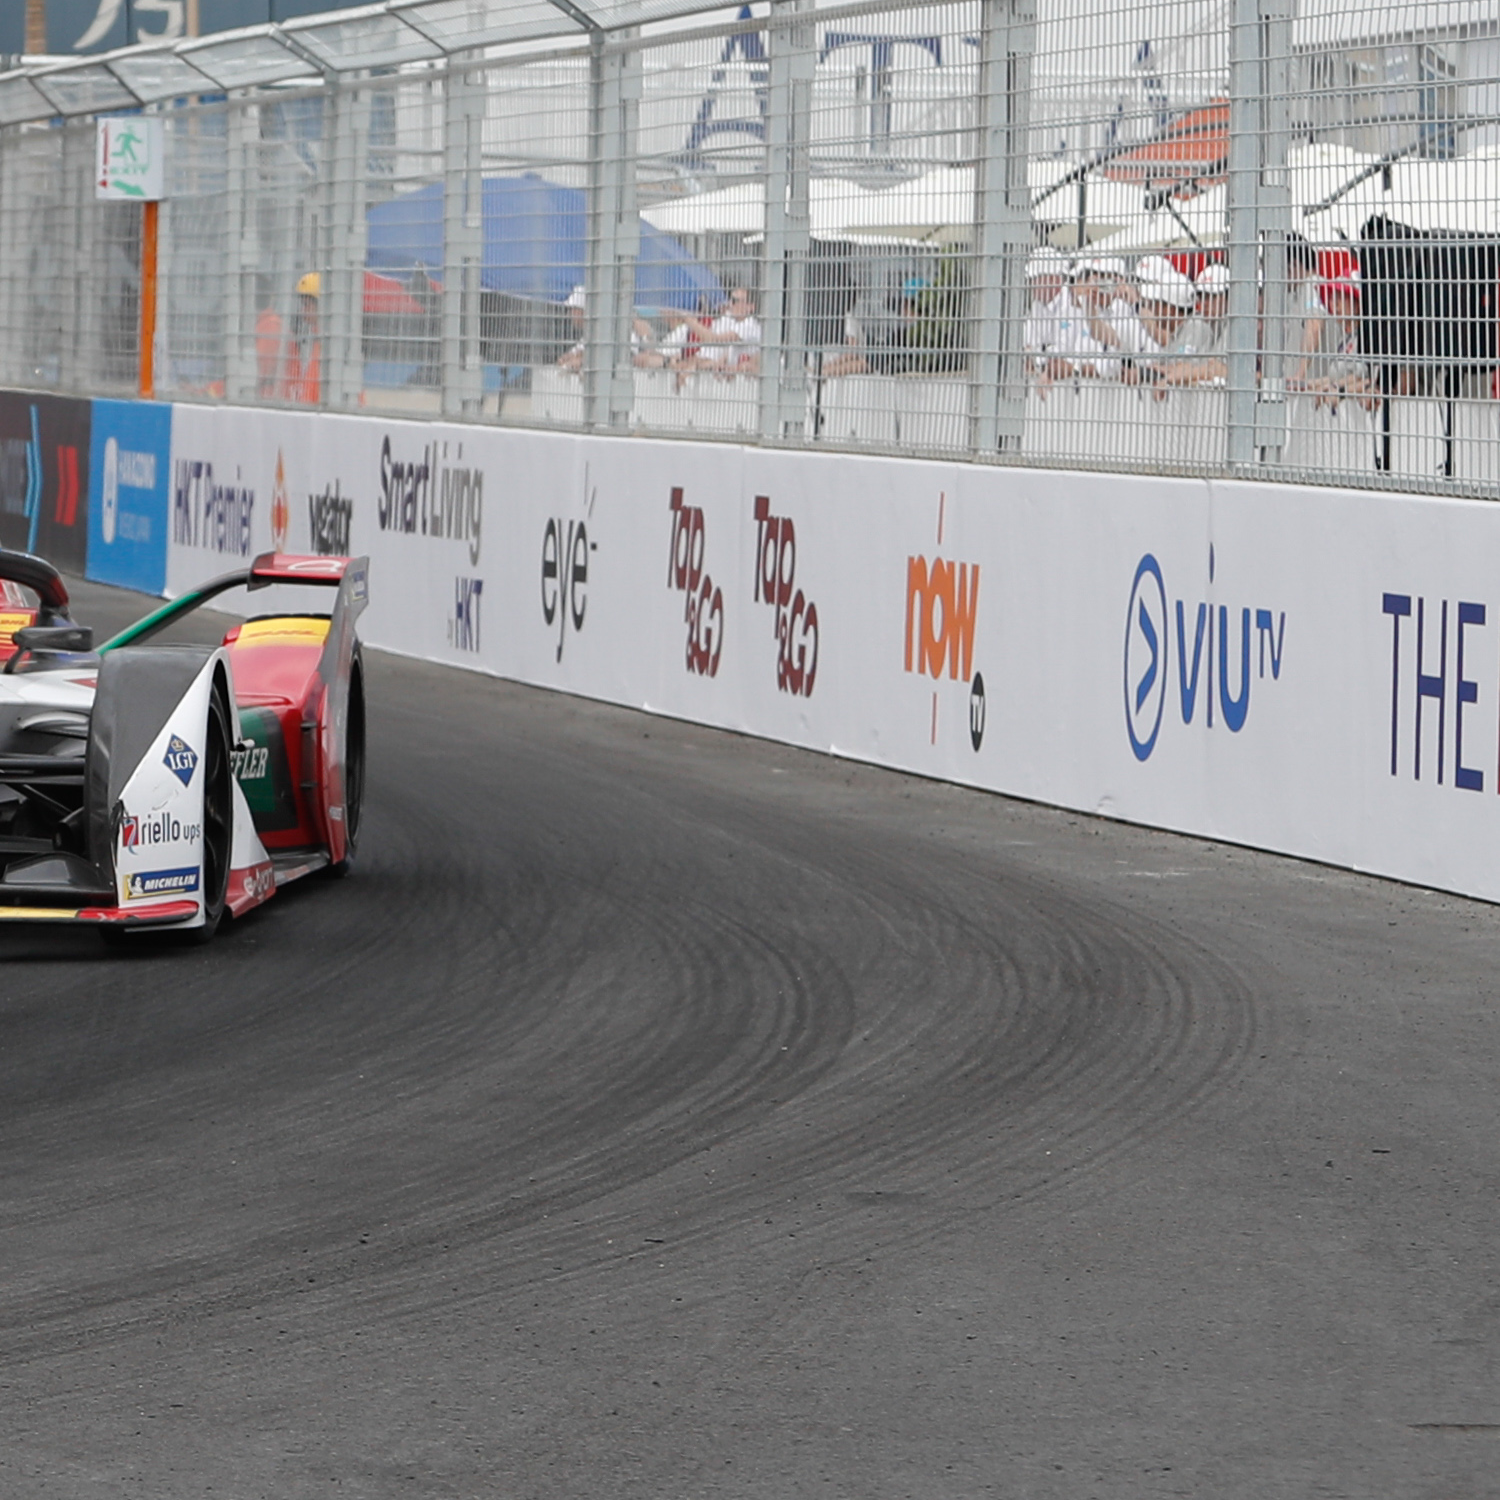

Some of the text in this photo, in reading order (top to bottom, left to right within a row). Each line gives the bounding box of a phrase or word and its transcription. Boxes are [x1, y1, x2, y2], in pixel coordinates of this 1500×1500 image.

[378, 434, 429, 536] Smart
[430, 440, 485, 567] Living
[667, 486, 706, 623] Tap
[455, 575, 483, 653] HKT
[541, 516, 589, 664] eye
[753, 495, 797, 640] Tap
[904, 554, 980, 684] now
[1382, 592, 1487, 793] THE
[167, 752, 195, 771] LGT
[141, 812, 200, 846] riello ups
[144, 873, 197, 891] MICHELIN
